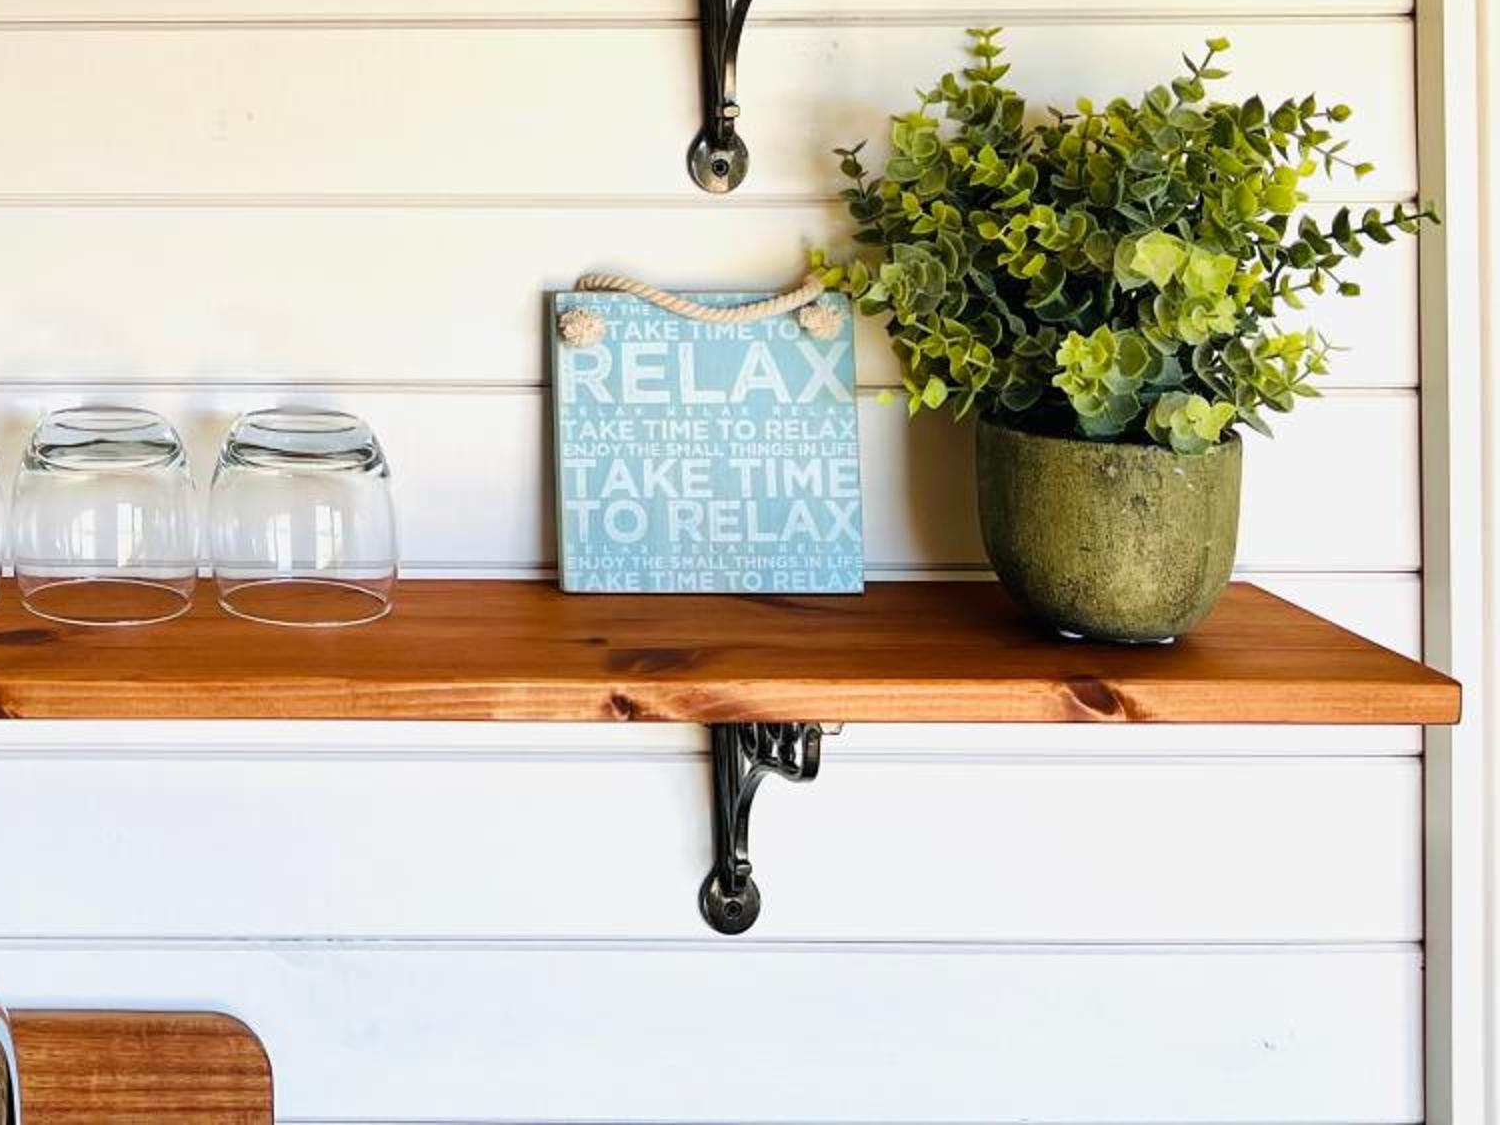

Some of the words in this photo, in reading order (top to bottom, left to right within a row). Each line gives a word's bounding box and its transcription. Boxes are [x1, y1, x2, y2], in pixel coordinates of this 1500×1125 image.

[607, 320, 680, 341] TAKE
[690, 320, 754, 341] TIME
[760, 319, 800, 341] TO
[559, 340, 853, 404] RELAX
[560, 419, 635, 441] TAKE
[642, 419, 709, 441] TIME
[717, 419, 757, 441] TO
[765, 418, 856, 441] RELAX
[563, 442, 621, 457] ENJOY
[625, 442, 661, 456] THE
[665, 442, 725, 456] SMALL
[730, 442, 795, 456] THINGS
[799, 442, 817, 456] IN
[821, 442, 860, 456] LIFE
[563, 458, 713, 498] TAKE
[729, 458, 860, 498] TIME
[566, 499, 649, 543] TO
[668, 500, 862, 542] RELAX
[567, 556, 625, 570] ENJOY
[628, 556, 665, 570] THE
[670, 556, 727, 570] SMALL
[734, 556, 800, 569] THINGS
[804, 556, 821, 569] IN
[827, 556, 864, 569] LIFE
[568, 571, 641, 591] TAKE
[649, 571, 716, 591] TIME
[724, 571, 762, 591] TO
[773, 571, 862, 591] RELAX
